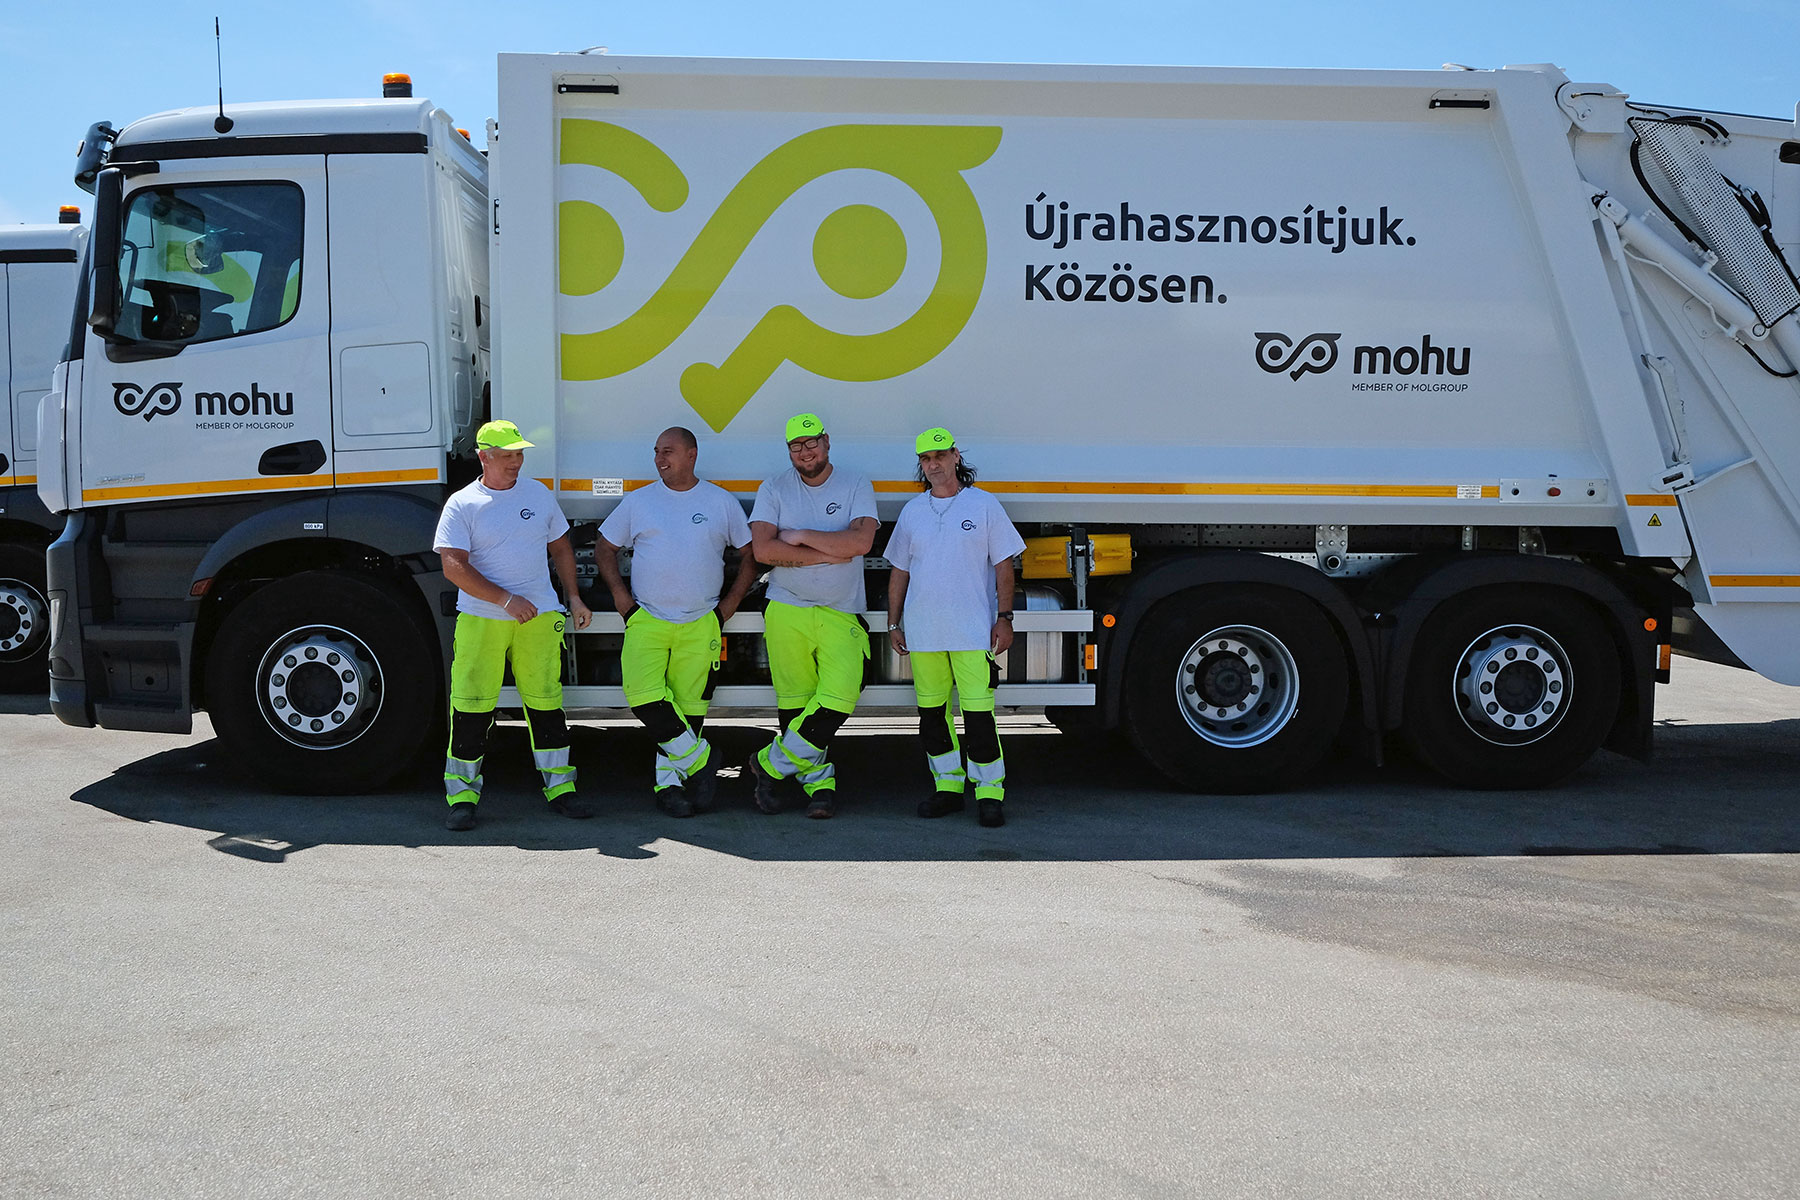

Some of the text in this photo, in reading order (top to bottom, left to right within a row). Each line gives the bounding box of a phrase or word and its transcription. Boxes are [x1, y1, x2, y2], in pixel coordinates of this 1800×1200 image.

[1025, 191, 1417, 253] Újrahasznosítjuk.
[1025, 262, 1228, 304] Közösen.
[1353, 334, 1471, 376] mohu
[195, 382, 294, 416] mohu
[381, 387, 386, 395] 1
[1351, 383, 1469, 393] MEMBER OF MOLGROUP
[195, 422, 295, 430] MEMBER OF MOLGROUP
